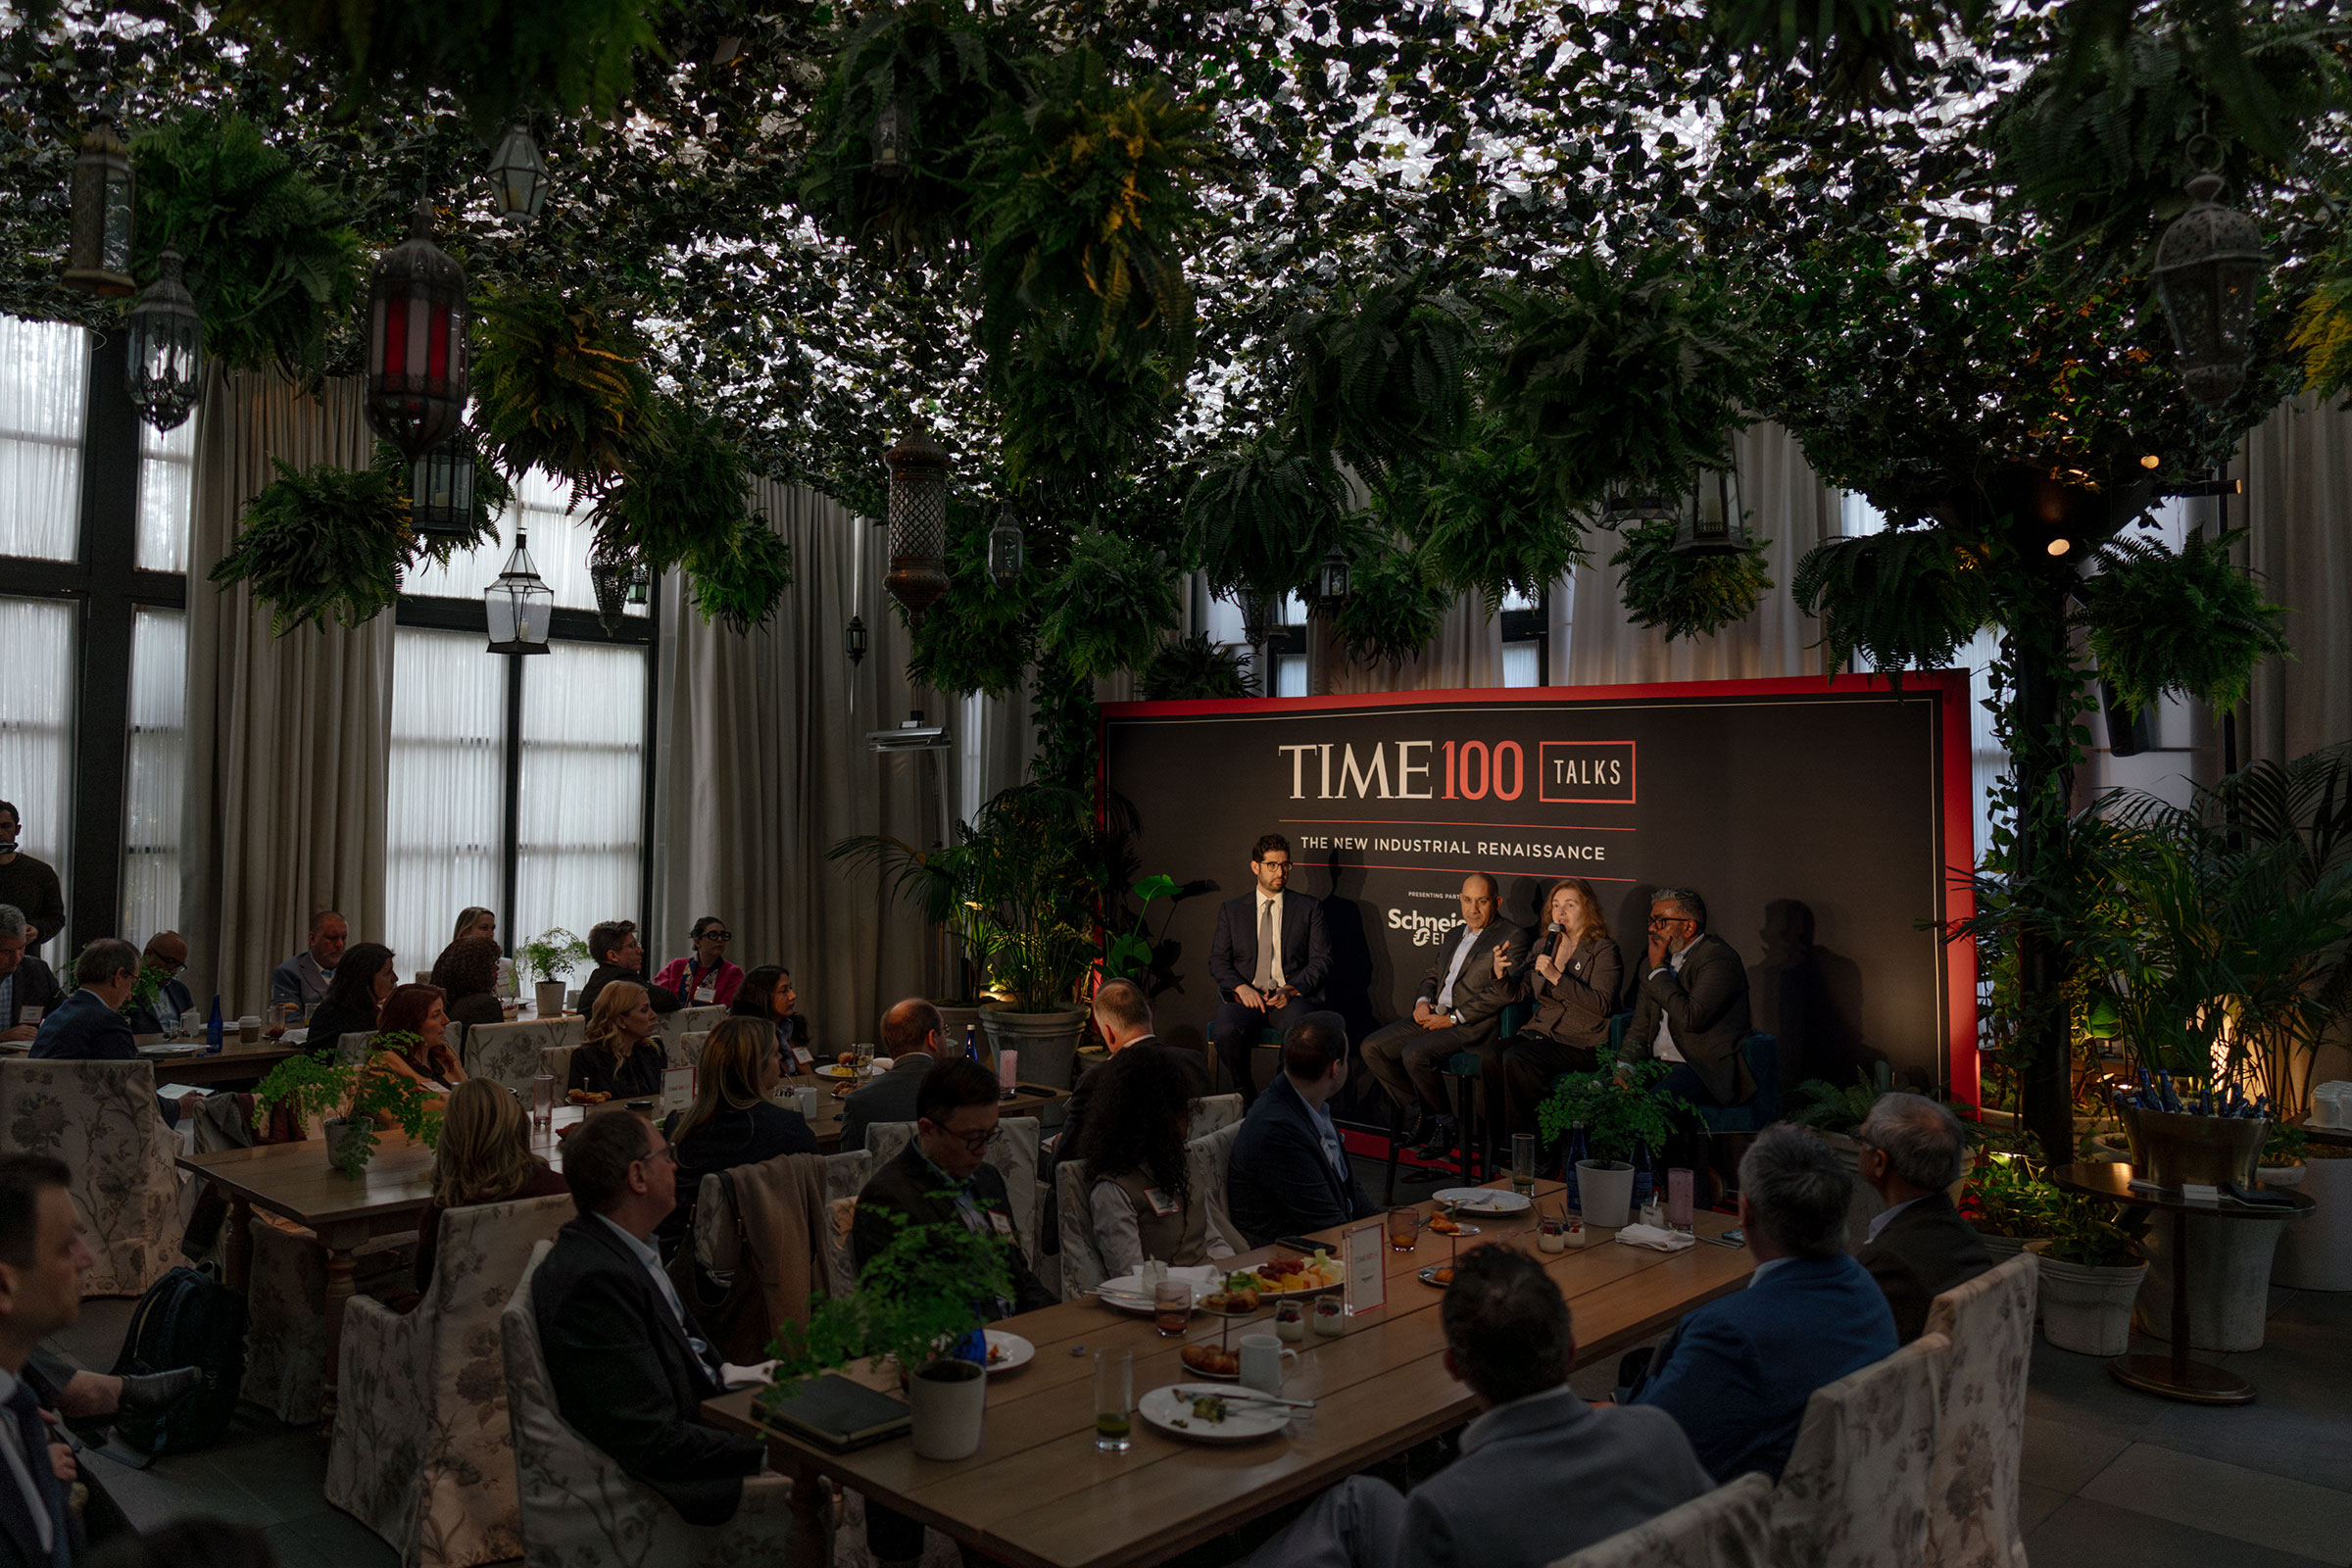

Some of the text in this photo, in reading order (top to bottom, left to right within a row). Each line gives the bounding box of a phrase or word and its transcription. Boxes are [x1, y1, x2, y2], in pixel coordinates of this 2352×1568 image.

[1553, 760, 1622, 786] TALKS
[1300, 836, 1606, 861] THE NEW INDUSTRIAL RENAISSANCE
[1407, 891, 1445, 900] PRESENTING
